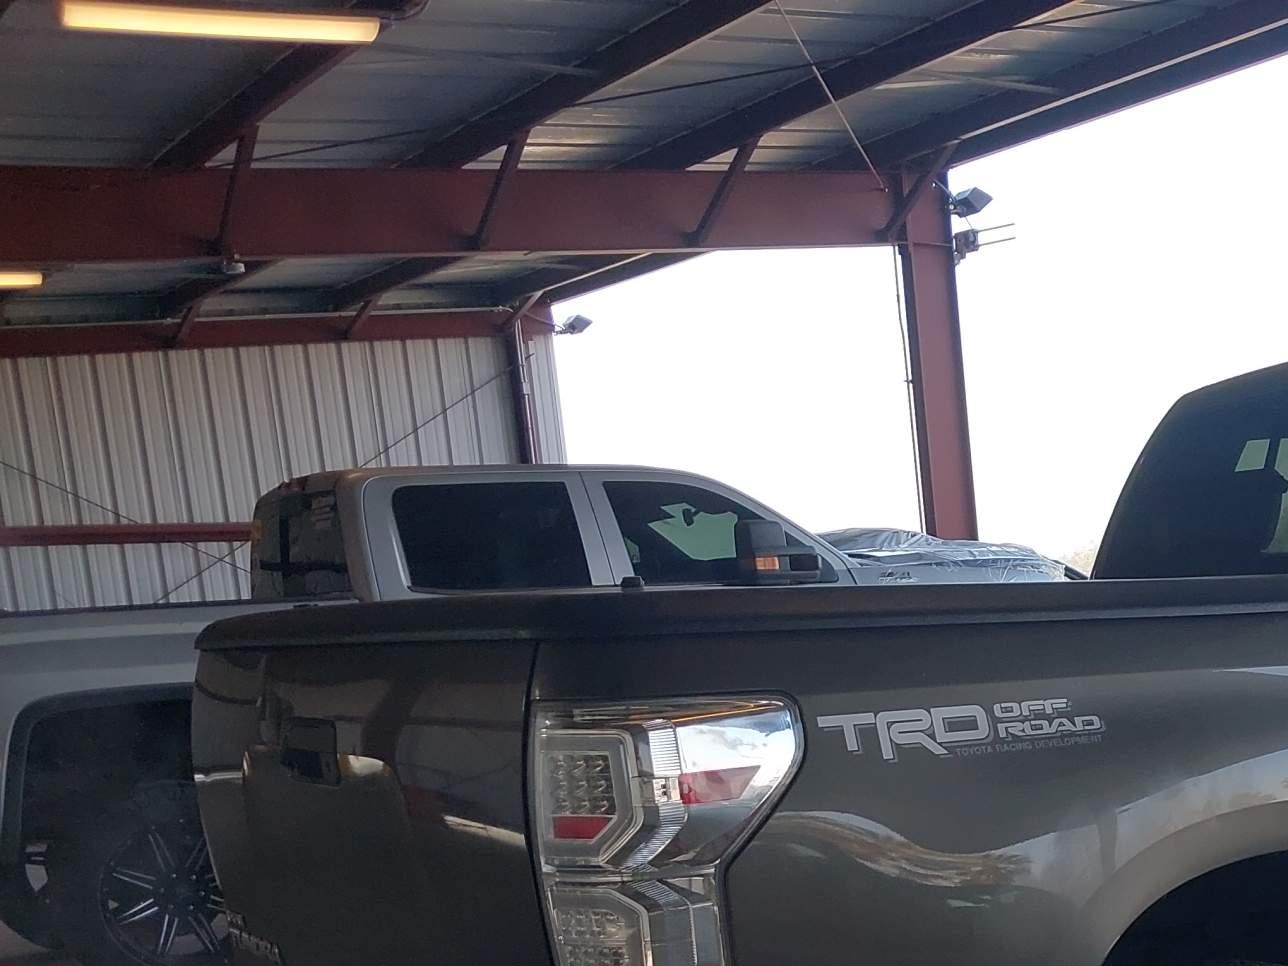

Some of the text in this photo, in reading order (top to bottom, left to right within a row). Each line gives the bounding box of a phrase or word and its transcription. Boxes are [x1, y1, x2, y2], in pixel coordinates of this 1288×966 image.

[993, 698, 1071, 719] OFF
[816, 704, 991, 762] TRD
[997, 715, 1105, 740] ROAD
[956, 734, 1104, 757] TOYOTA RACING DEVELOPMENT
